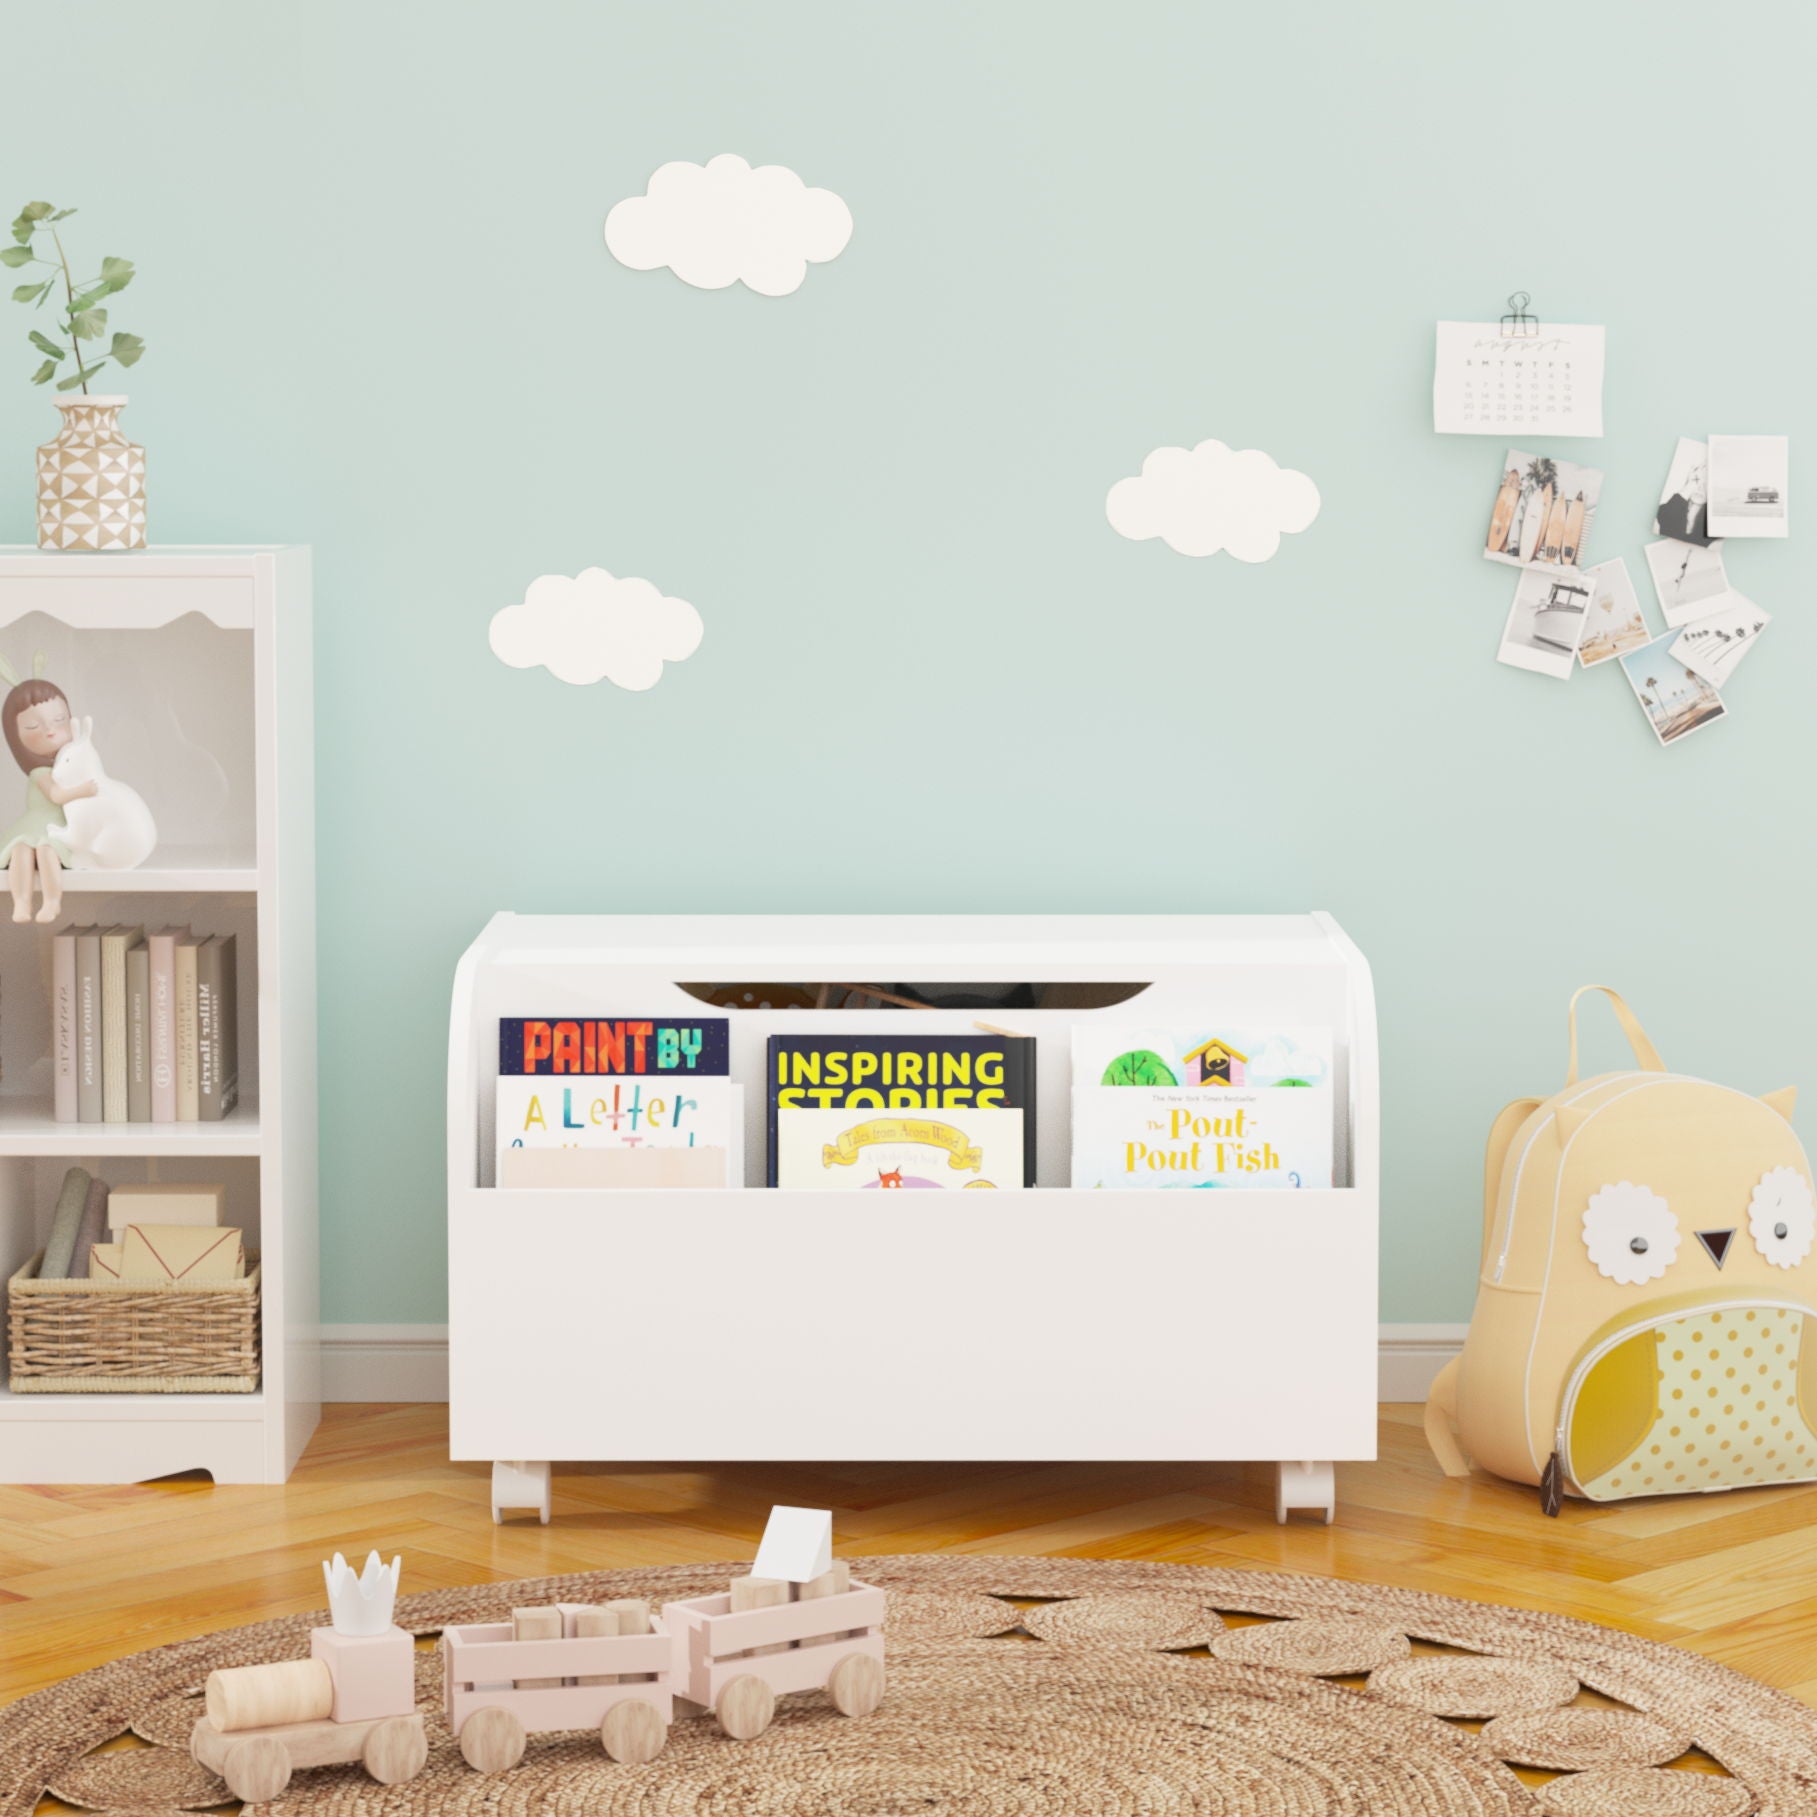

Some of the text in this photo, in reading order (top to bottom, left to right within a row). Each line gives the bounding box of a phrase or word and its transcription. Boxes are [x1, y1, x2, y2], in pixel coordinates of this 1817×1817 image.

[523, 1021, 702, 1073] PAINT BY
[778, 1052, 1004, 1085] INSPIRING
[524, 1084, 697, 1131] A Letter
[1146, 1108, 1257, 1139] The Pout-
[845, 1123, 961, 1149] Tales from Acorn Wood
[1122, 1141, 1280, 1173] Pout Fish
